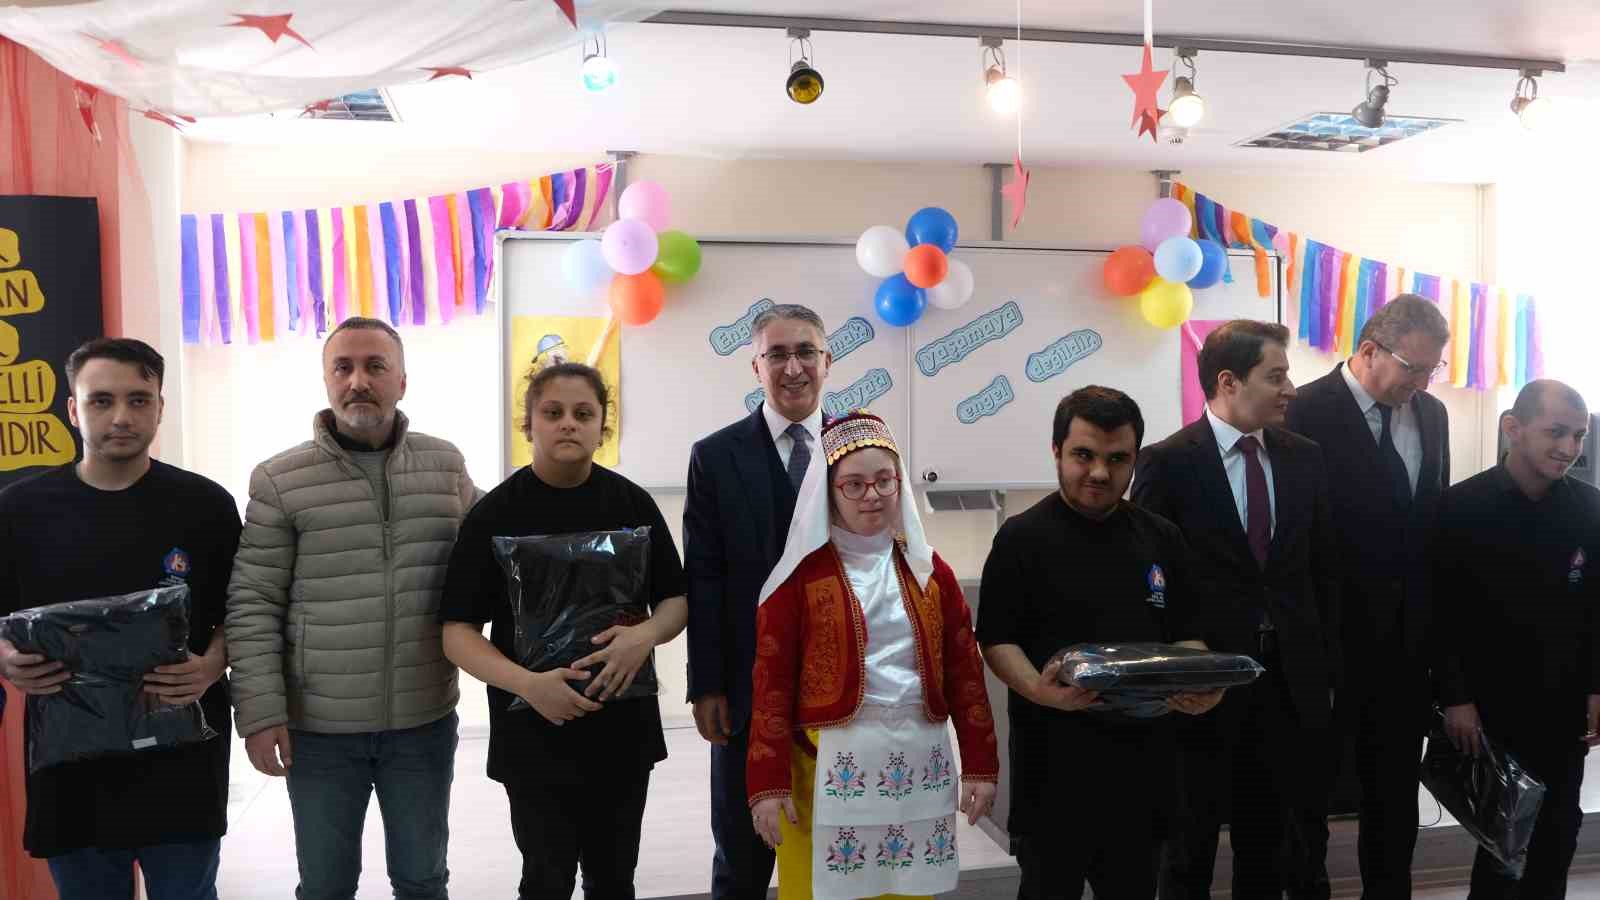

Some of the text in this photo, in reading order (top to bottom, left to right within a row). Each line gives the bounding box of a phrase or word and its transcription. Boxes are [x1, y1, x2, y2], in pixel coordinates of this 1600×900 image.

[918, 303, 1019, 372] yaşamaya
[1029, 332, 1100, 379] değildir
[960, 377, 1011, 421] engel
